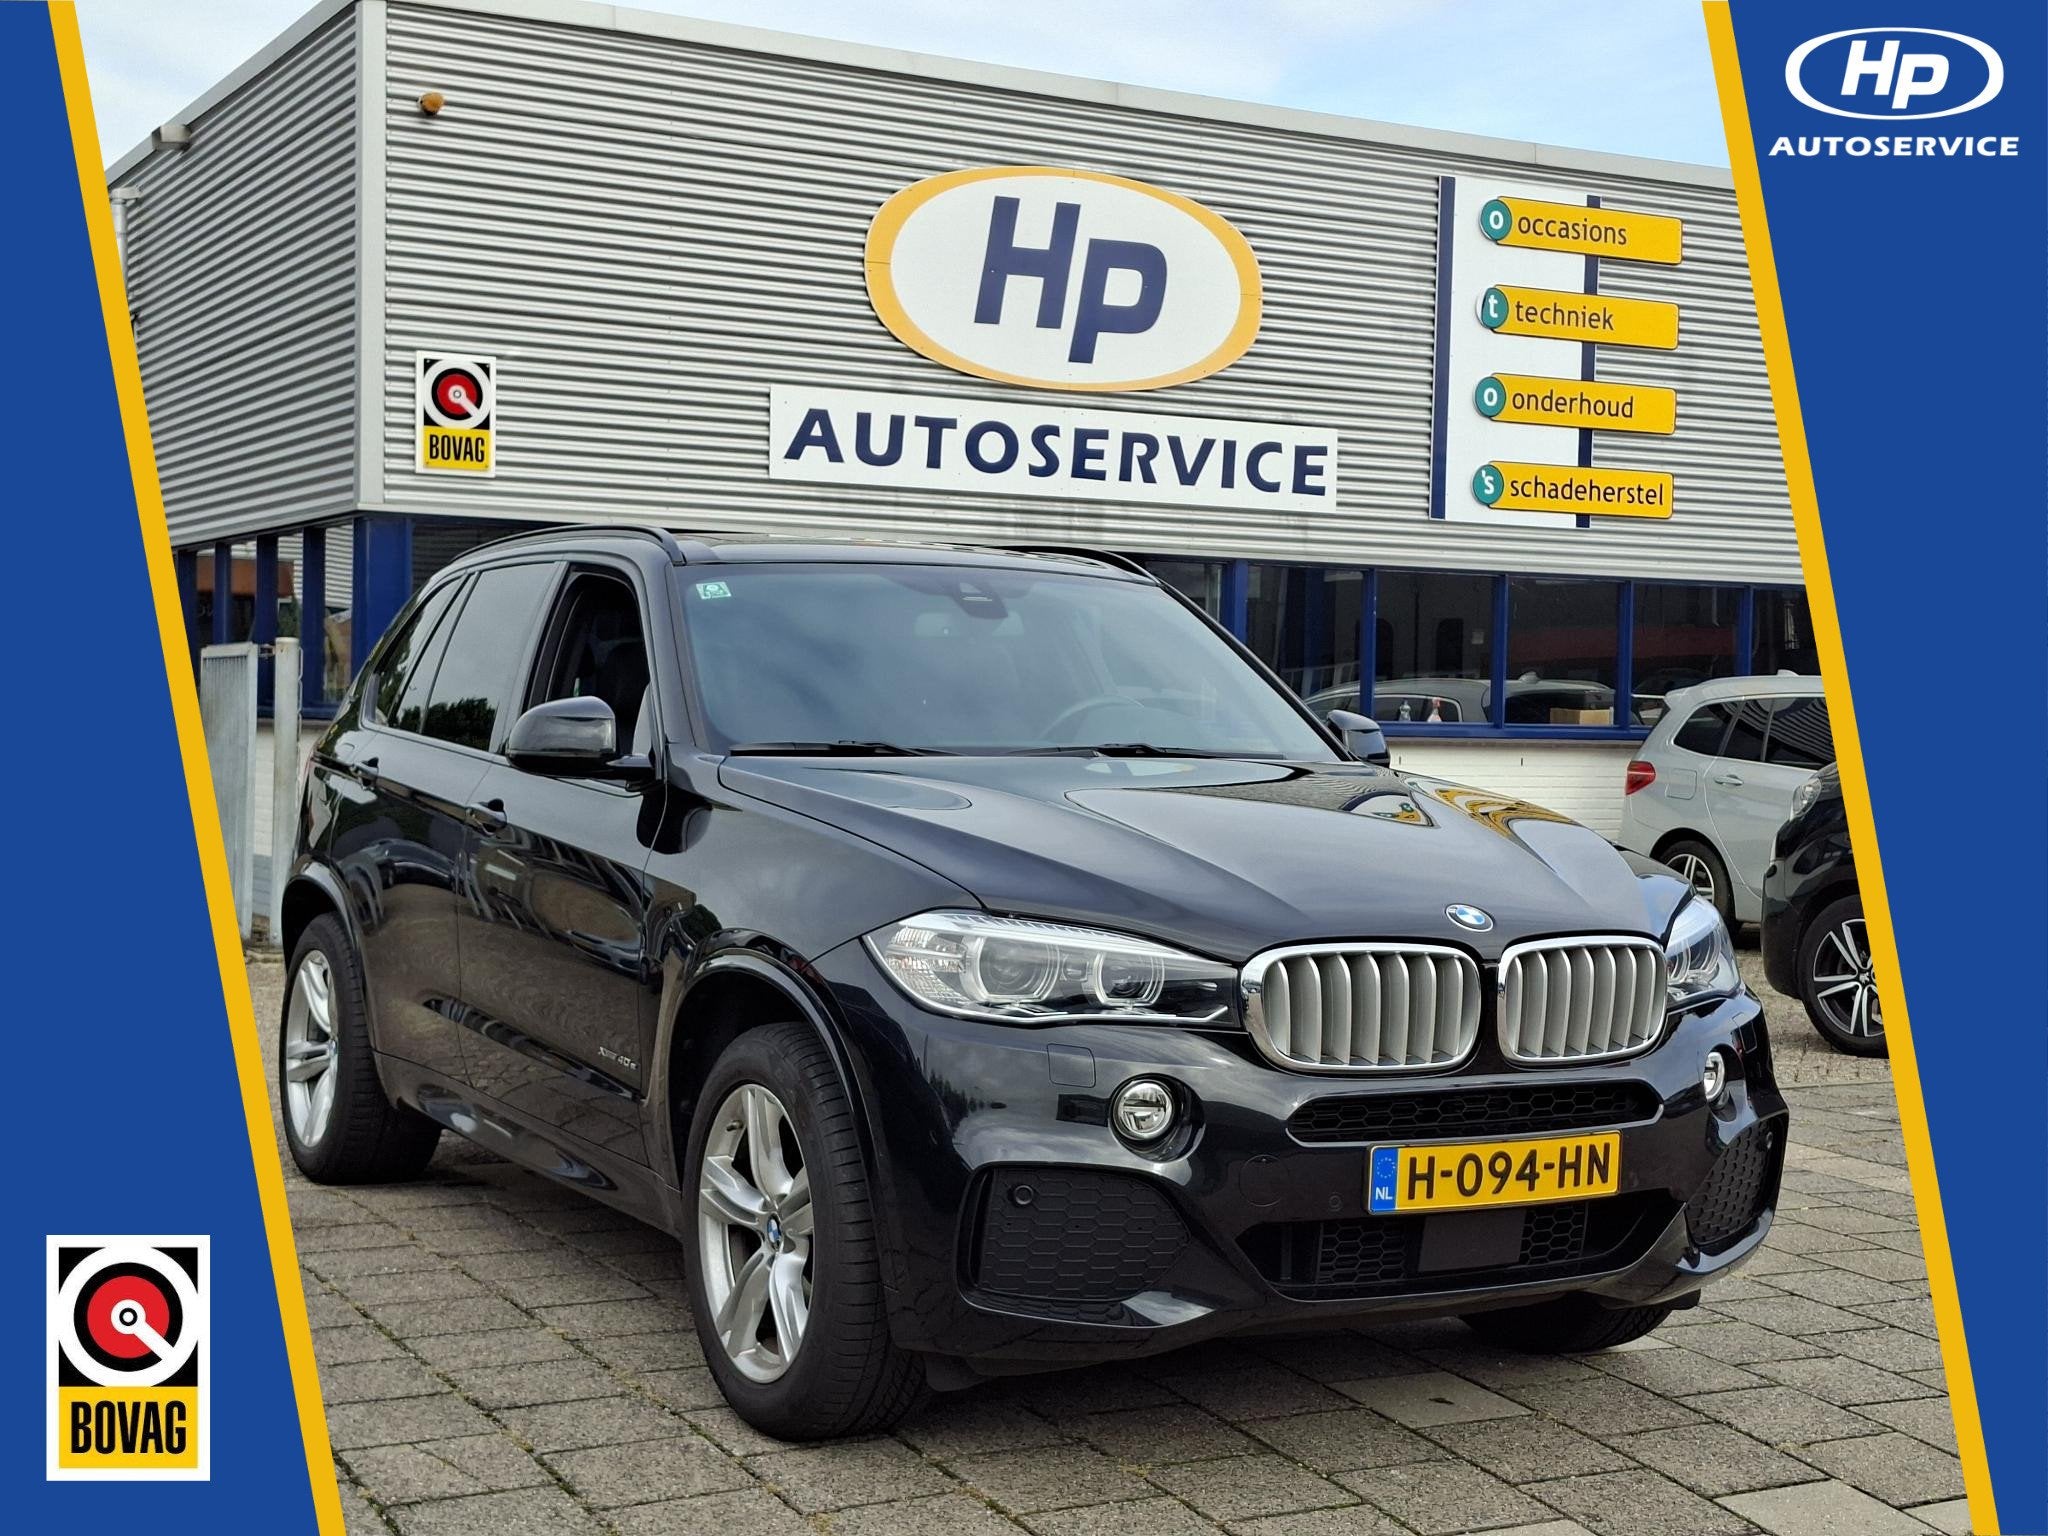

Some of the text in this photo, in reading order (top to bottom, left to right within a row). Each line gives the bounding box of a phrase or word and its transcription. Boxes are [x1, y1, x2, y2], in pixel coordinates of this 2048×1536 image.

[1517, 215, 1627, 245] occasions
[1515, 300, 1615, 331] techniek
[1511, 389, 1634, 418] onderhoud
[429, 434, 485, 463] BOVAG
[783, 408, 1328, 497] AUTOSERVICE
[1510, 475, 1664, 506] schadeherstel
[1407, 1142, 1611, 1201] H-094-HN
[1375, 1186, 1393, 1200] NL
